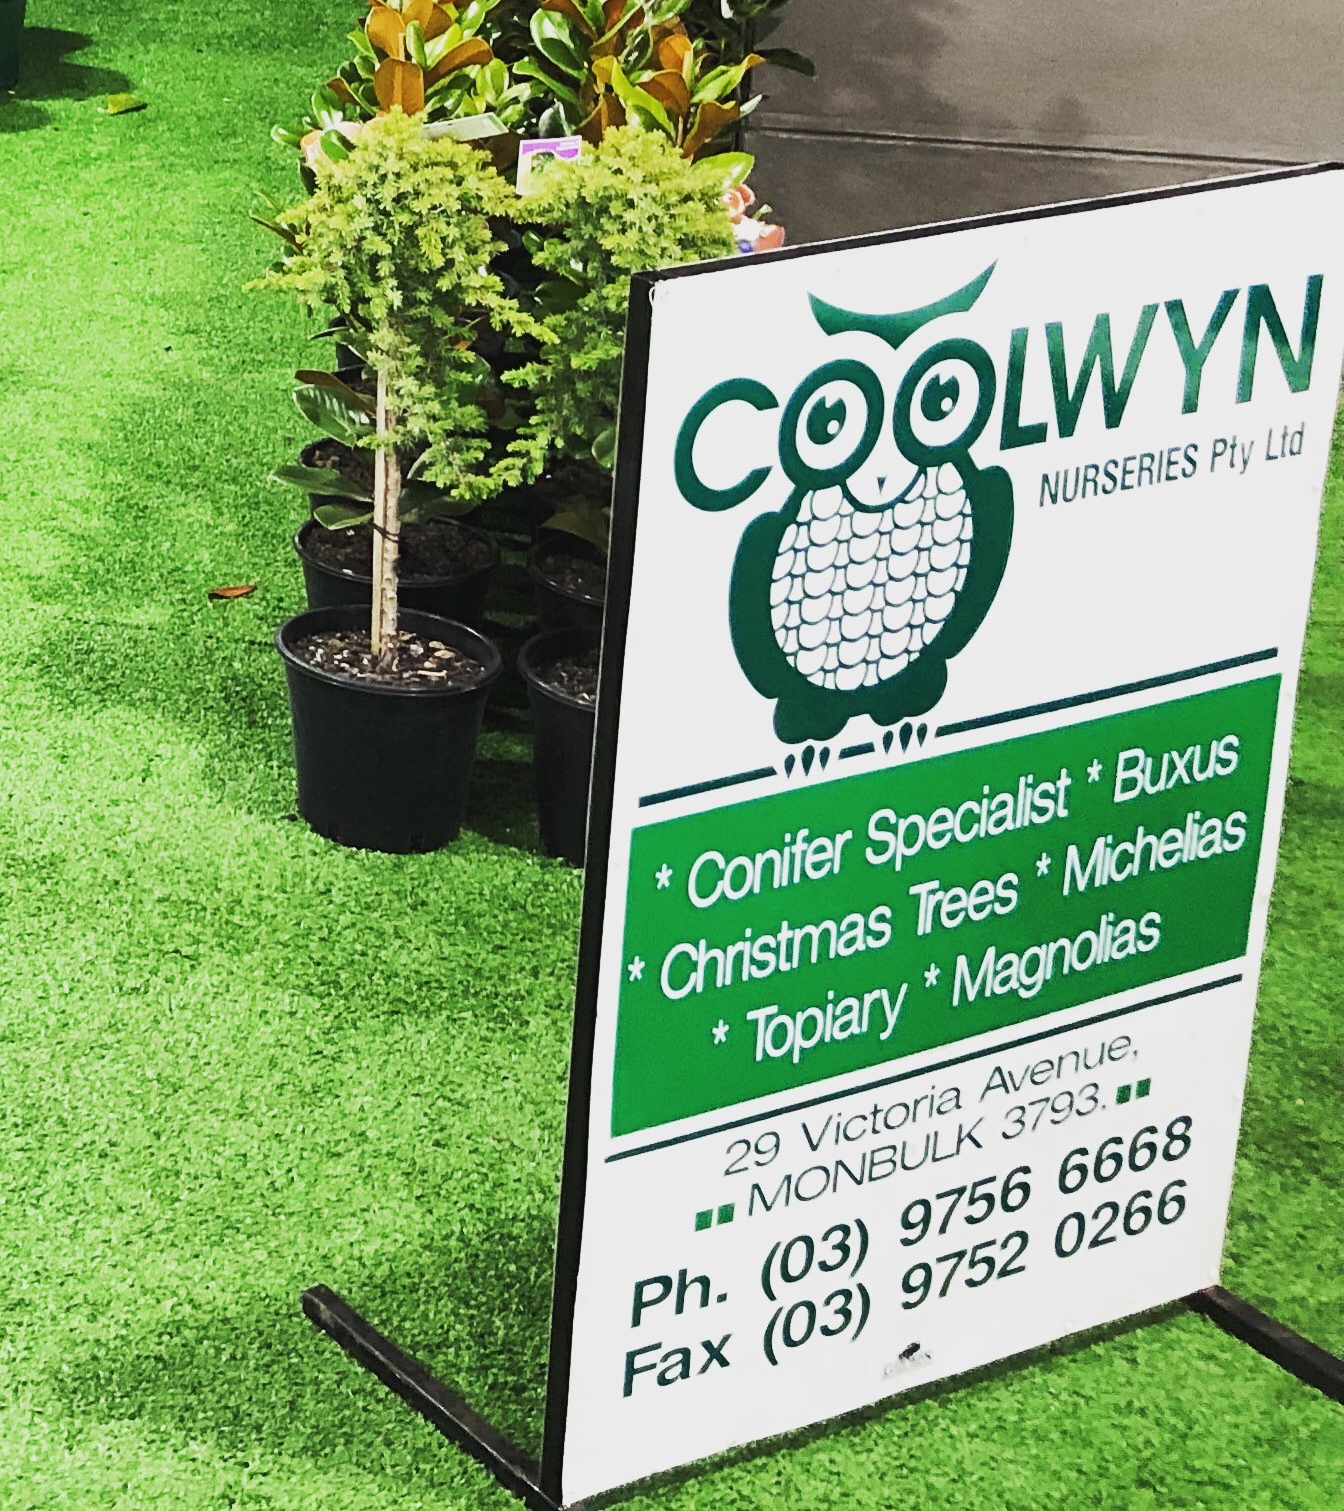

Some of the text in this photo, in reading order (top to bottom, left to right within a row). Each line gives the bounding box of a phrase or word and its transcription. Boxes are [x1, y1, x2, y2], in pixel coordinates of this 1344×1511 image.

[675, 274, 1323, 512] COOLWYN
[1039, 421, 1306, 507] NURSERIES Pty Ltd
[660, 810, 1248, 1000] Christmas Trees Michelias
[688, 734, 1240, 908] Conifer Specialist Buxus
[746, 911, 1162, 1064] Topiary Magnolias
[724, 1035, 1139, 1177] 29 Victoria Avenue,
[748, 1082, 1107, 1217] MONBULK 3793.
[622, 1179, 1188, 1398] Fax (03) 9752 0266
[630, 1115, 1193, 1329] Ph. (03) 9756 6668
